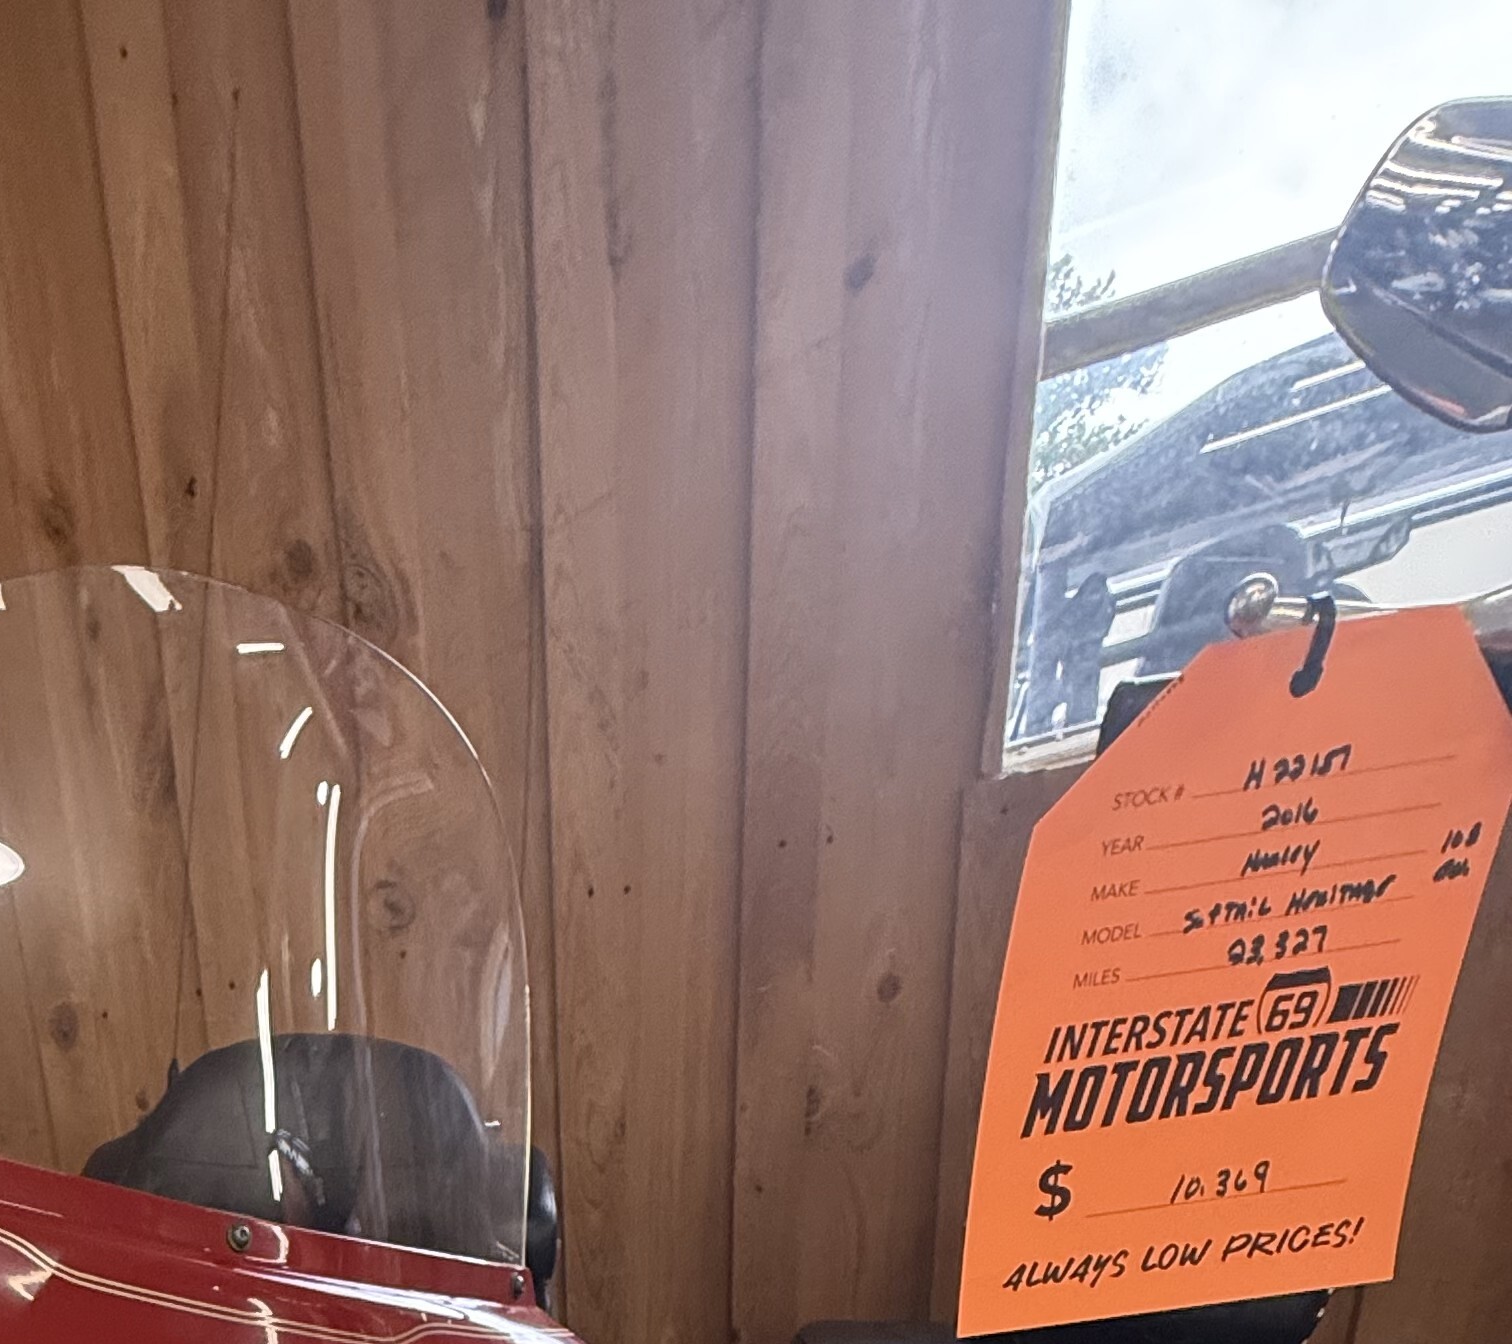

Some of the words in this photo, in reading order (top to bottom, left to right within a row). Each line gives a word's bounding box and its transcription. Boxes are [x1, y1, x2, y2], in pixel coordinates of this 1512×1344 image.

[1113, 787, 1172, 811] STOCK
[1101, 835, 1145, 856] YEAR
[1261, 797, 1319, 831] 2016
[1090, 880, 1141, 902] MAKE
[1080, 923, 1143, 946] MODEL
[1072, 967, 1122, 991] MILES
[1043, 998, 1255, 1064] INTERSTATE
[1264, 989, 1320, 1033] 69
[1019, 1022, 1400, 1138] MOTORSPORTS
[1002, 1250, 1130, 1292] ALWAYS
[1140, 1239, 1213, 1273] LOW
[1221, 1216, 1366, 1263] PRICES!
